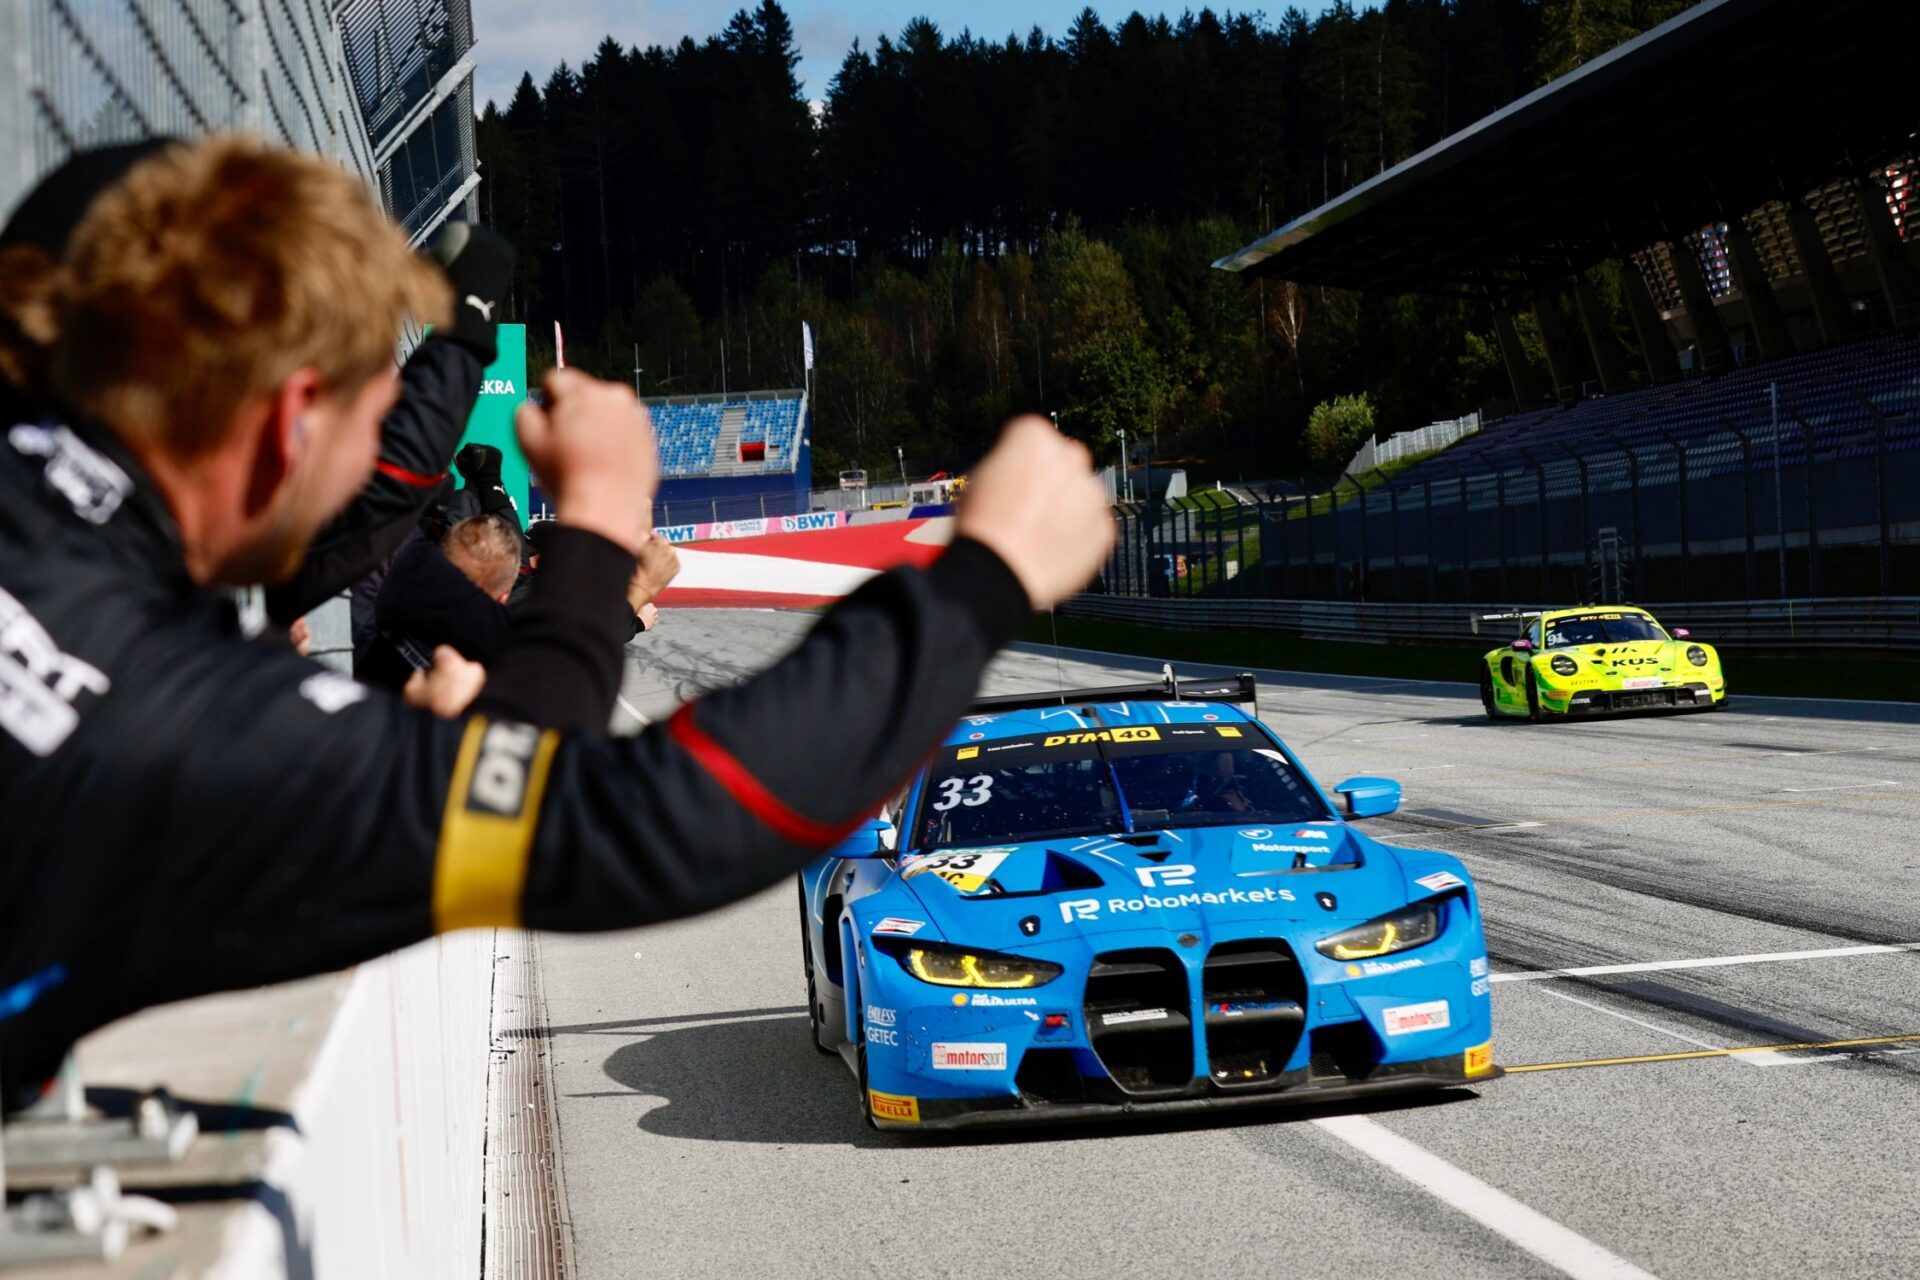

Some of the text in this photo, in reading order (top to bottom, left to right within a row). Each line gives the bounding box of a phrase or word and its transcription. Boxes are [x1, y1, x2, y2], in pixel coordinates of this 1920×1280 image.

[798, 513, 836, 529] BWT
[1044, 729, 1152, 747] DTM 40
[932, 774, 994, 812] 33
[1251, 843, 1332, 854] Motorsport
[926, 854, 983, 870] 33
[1108, 887, 1297, 914] RoboMarkets
[867, 1027, 899, 1047] GETEC
[871, 1094, 912, 1117] PIRELLI
